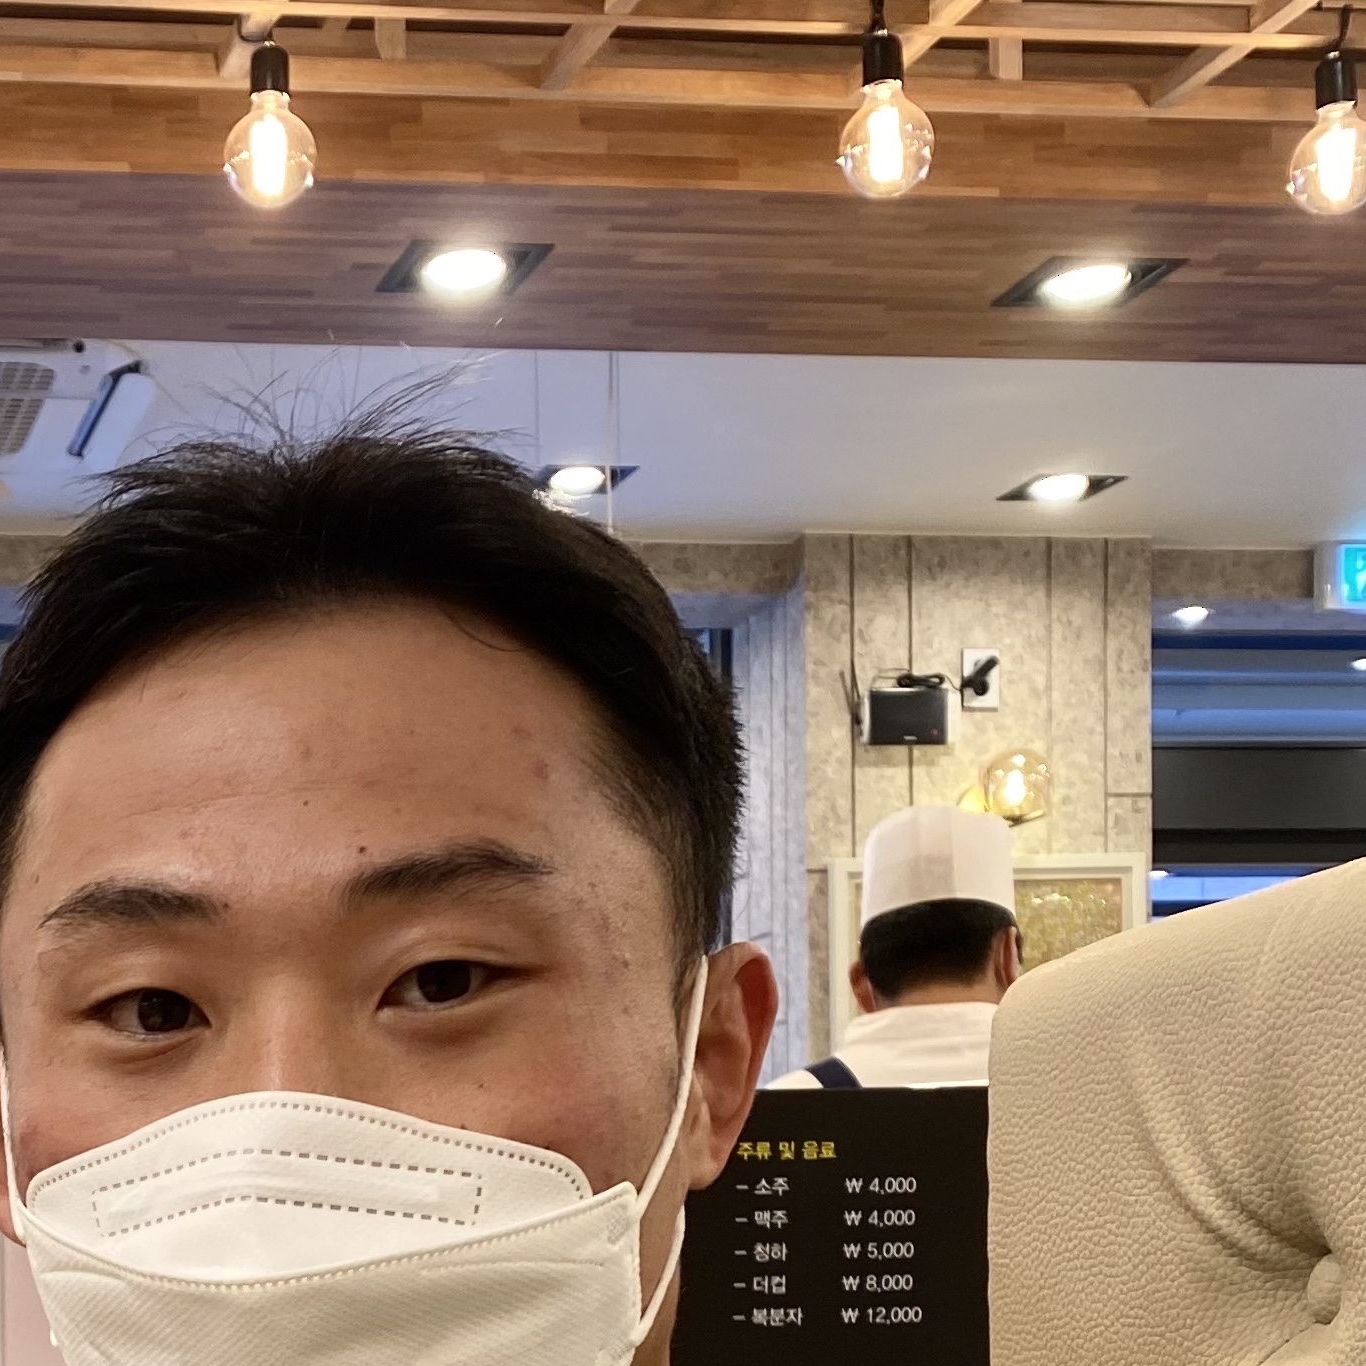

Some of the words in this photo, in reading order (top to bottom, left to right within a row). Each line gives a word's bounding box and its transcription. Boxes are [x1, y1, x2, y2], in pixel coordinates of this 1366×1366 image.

[737, 1141, 772, 1160] 주류
[779, 1140, 795, 1160] 및
[801, 1140, 837, 1160] 음료
[754, 1177, 790, 1196] 소주
[868, 1176, 918, 1196] 4,000
[754, 1209, 789, 1229] 맥주
[867, 1209, 916, 1228] 4,000
[753, 1241, 788, 1262] 청하
[866, 1241, 915, 1261] 5,000
[865, 1273, 914, 1294] 8,000
[752, 1306, 804, 1327] 복분자
[866, 1306, 923, 1326] 12,000
